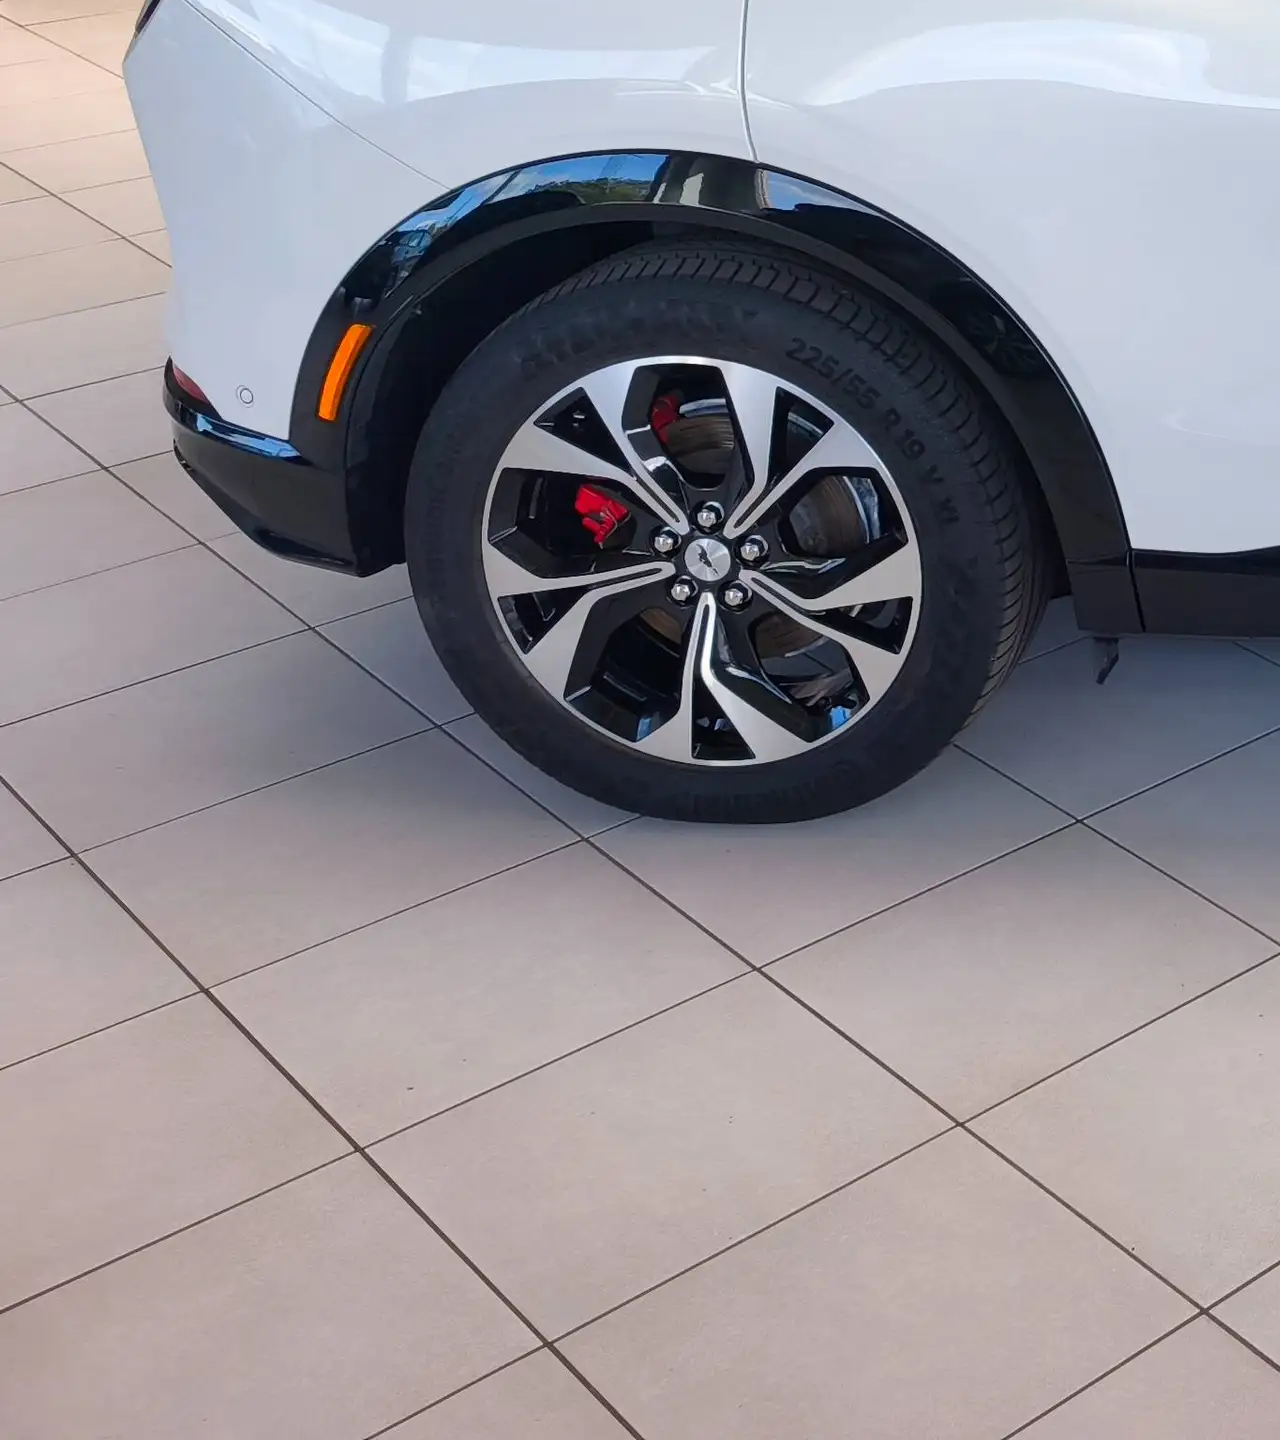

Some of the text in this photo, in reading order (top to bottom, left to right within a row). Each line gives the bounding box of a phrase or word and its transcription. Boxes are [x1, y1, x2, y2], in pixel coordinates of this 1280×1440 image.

[785, 337, 883, 409] 225/55
[881, 407, 902, 432] R
[894, 428, 926, 460] 19
